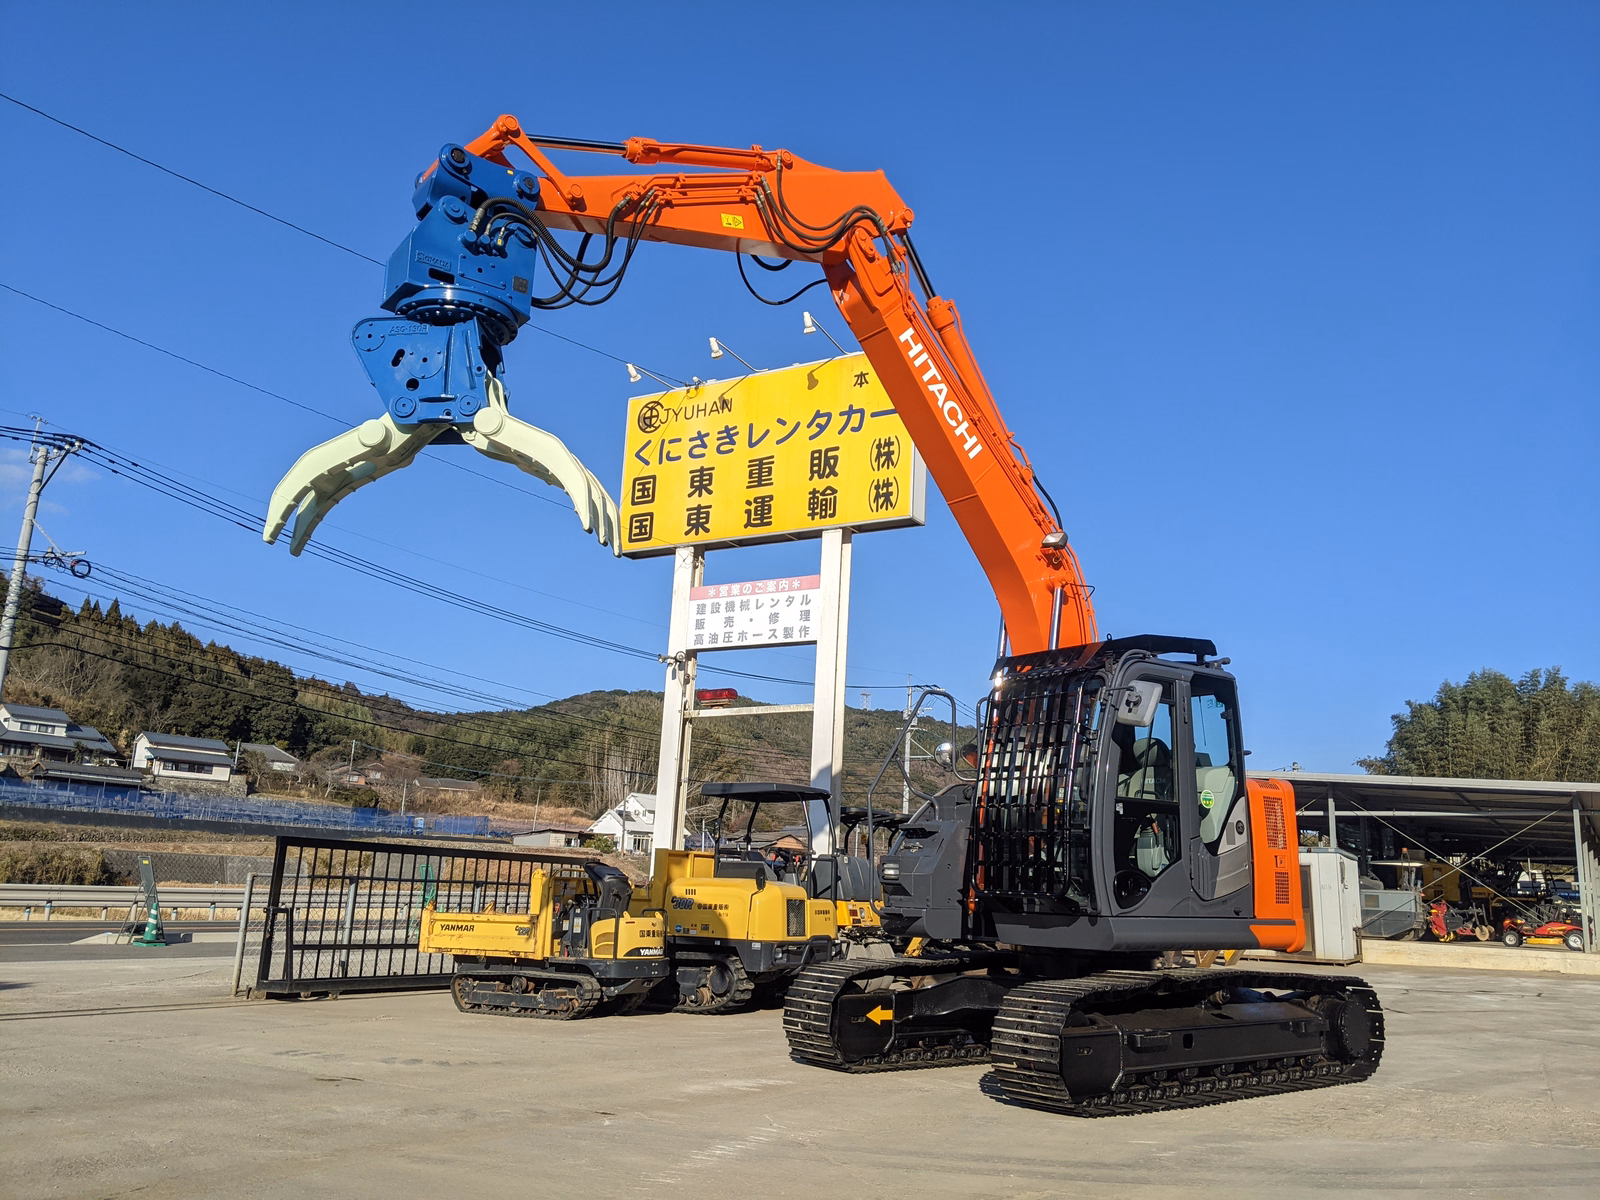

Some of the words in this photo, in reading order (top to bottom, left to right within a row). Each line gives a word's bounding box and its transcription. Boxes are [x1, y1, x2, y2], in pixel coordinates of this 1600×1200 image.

[898, 327, 983, 460] HITACHI
[659, 397, 733, 425] JYUHAN
[634, 404, 899, 466] くにさきレンタカー
[695, 594, 812, 616] 建設機械レンタル
[693, 625, 810, 646] 高油圧ホース製作
[440, 923, 475, 932] YANMAR
